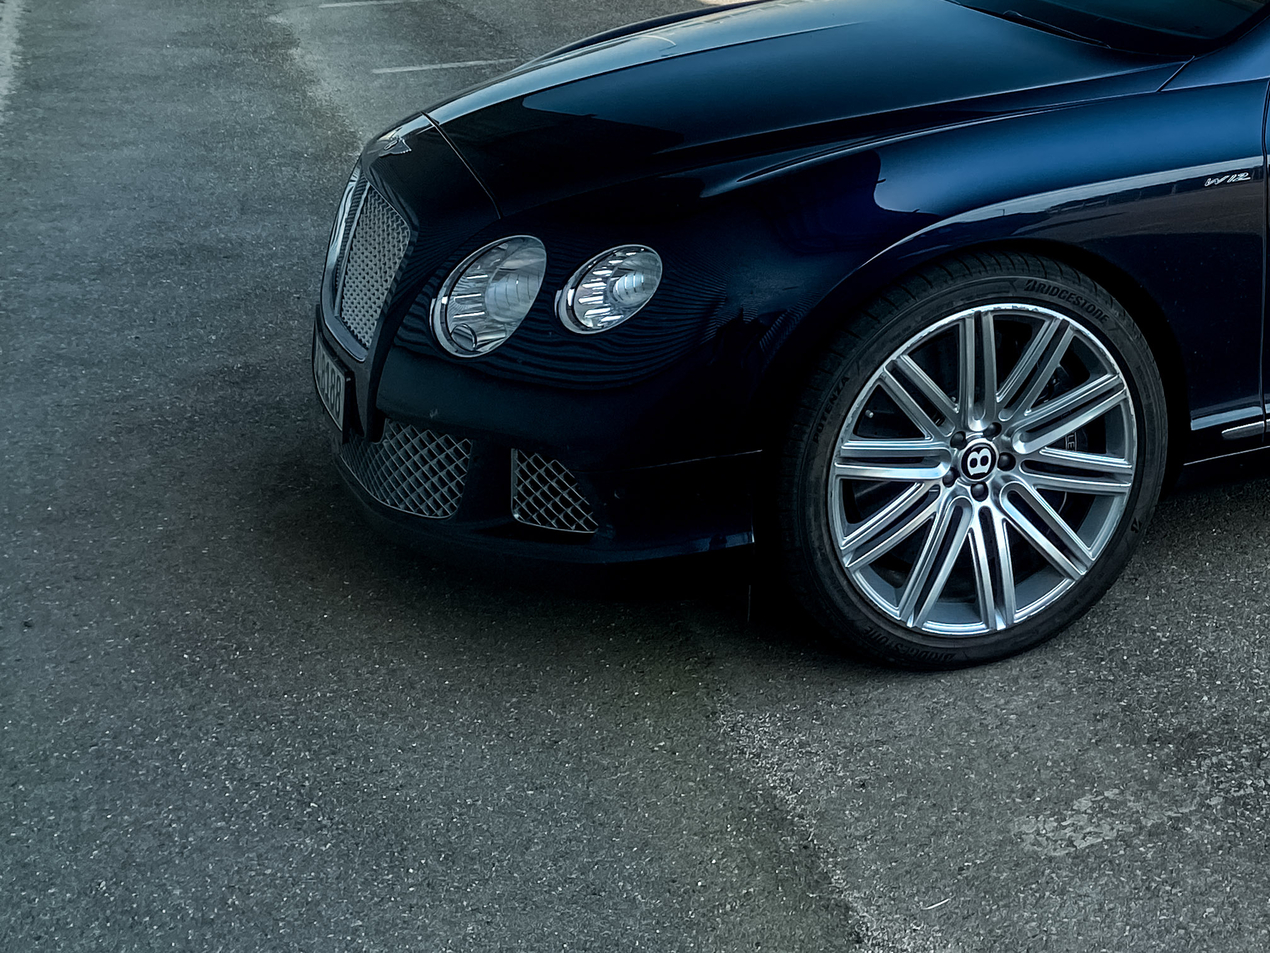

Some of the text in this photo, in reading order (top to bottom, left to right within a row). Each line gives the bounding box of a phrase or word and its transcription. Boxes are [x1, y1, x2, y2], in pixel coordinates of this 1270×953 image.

[1024, 279, 1109, 324] BRIDGESTONE
[813, 376, 850, 444] POTENZA
[966, 447, 992, 476] B
